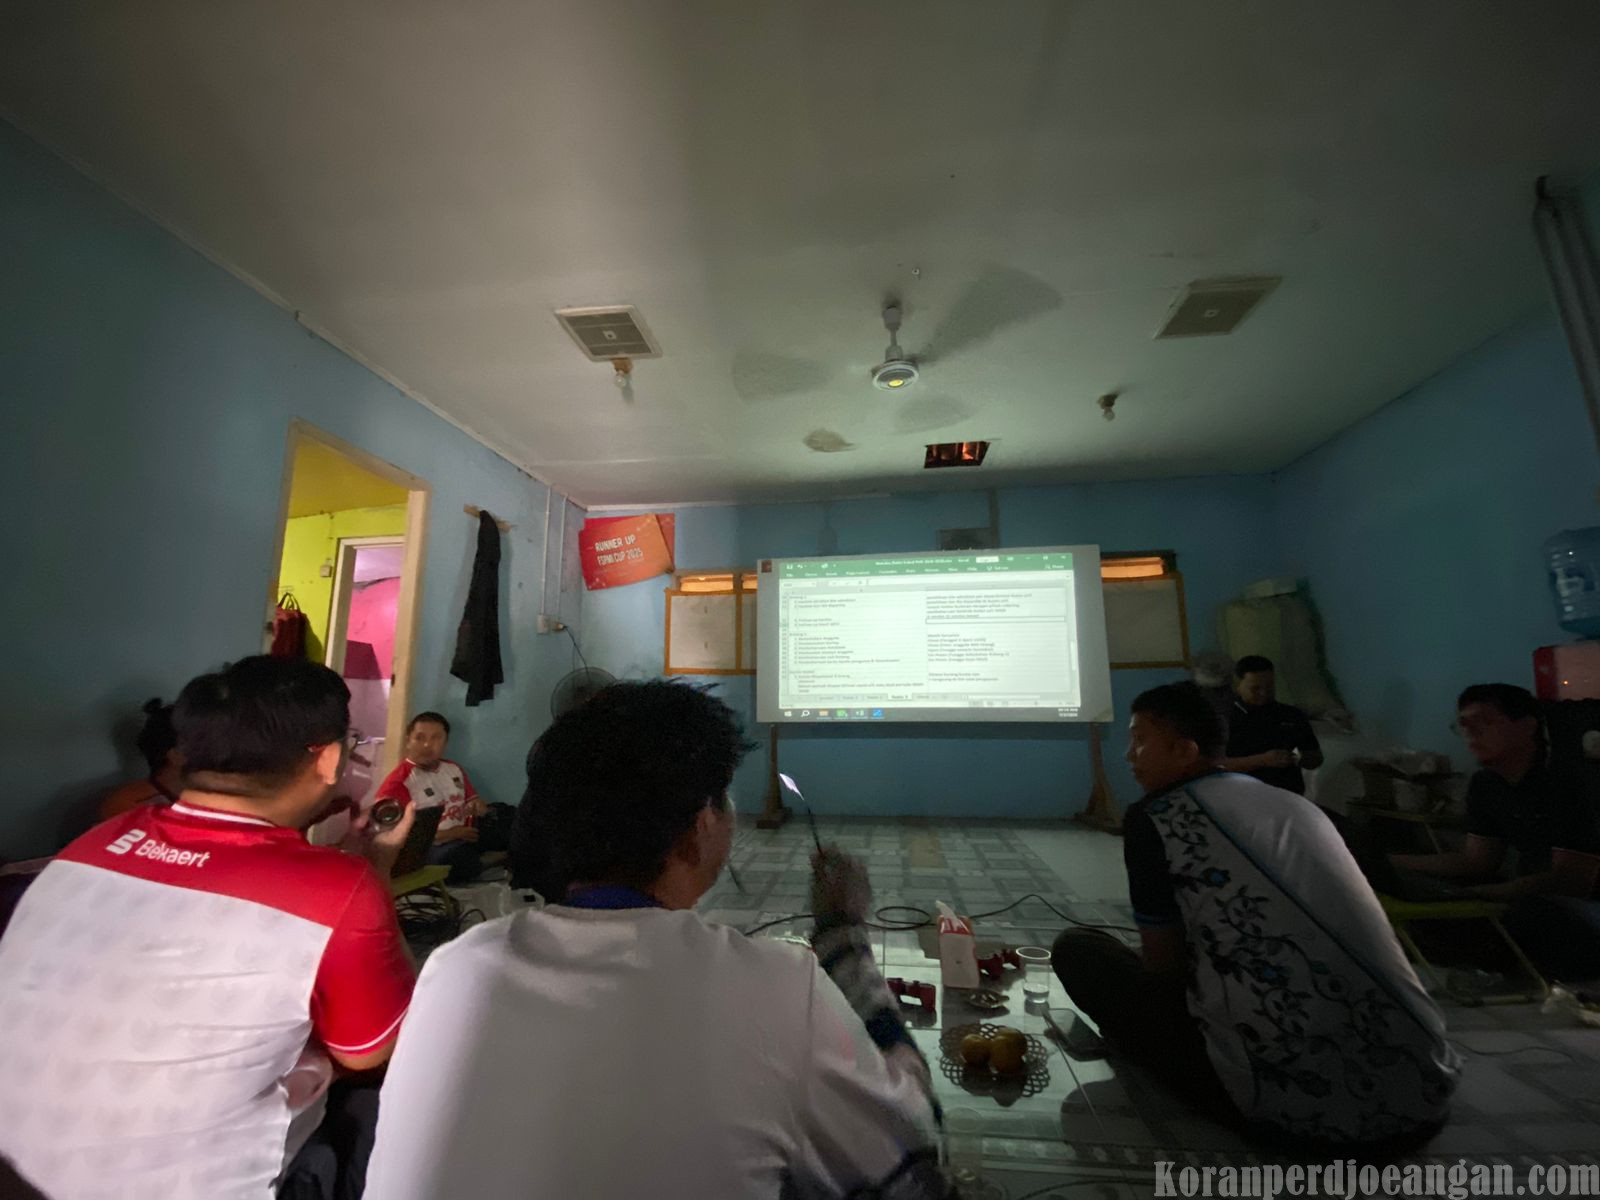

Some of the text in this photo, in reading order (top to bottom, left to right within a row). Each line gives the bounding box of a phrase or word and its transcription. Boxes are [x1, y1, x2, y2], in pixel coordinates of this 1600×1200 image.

[595, 534, 636, 552] RUNNER UP
[613, 551, 625, 562] CUP
[134, 838, 211, 868] Bekaert
